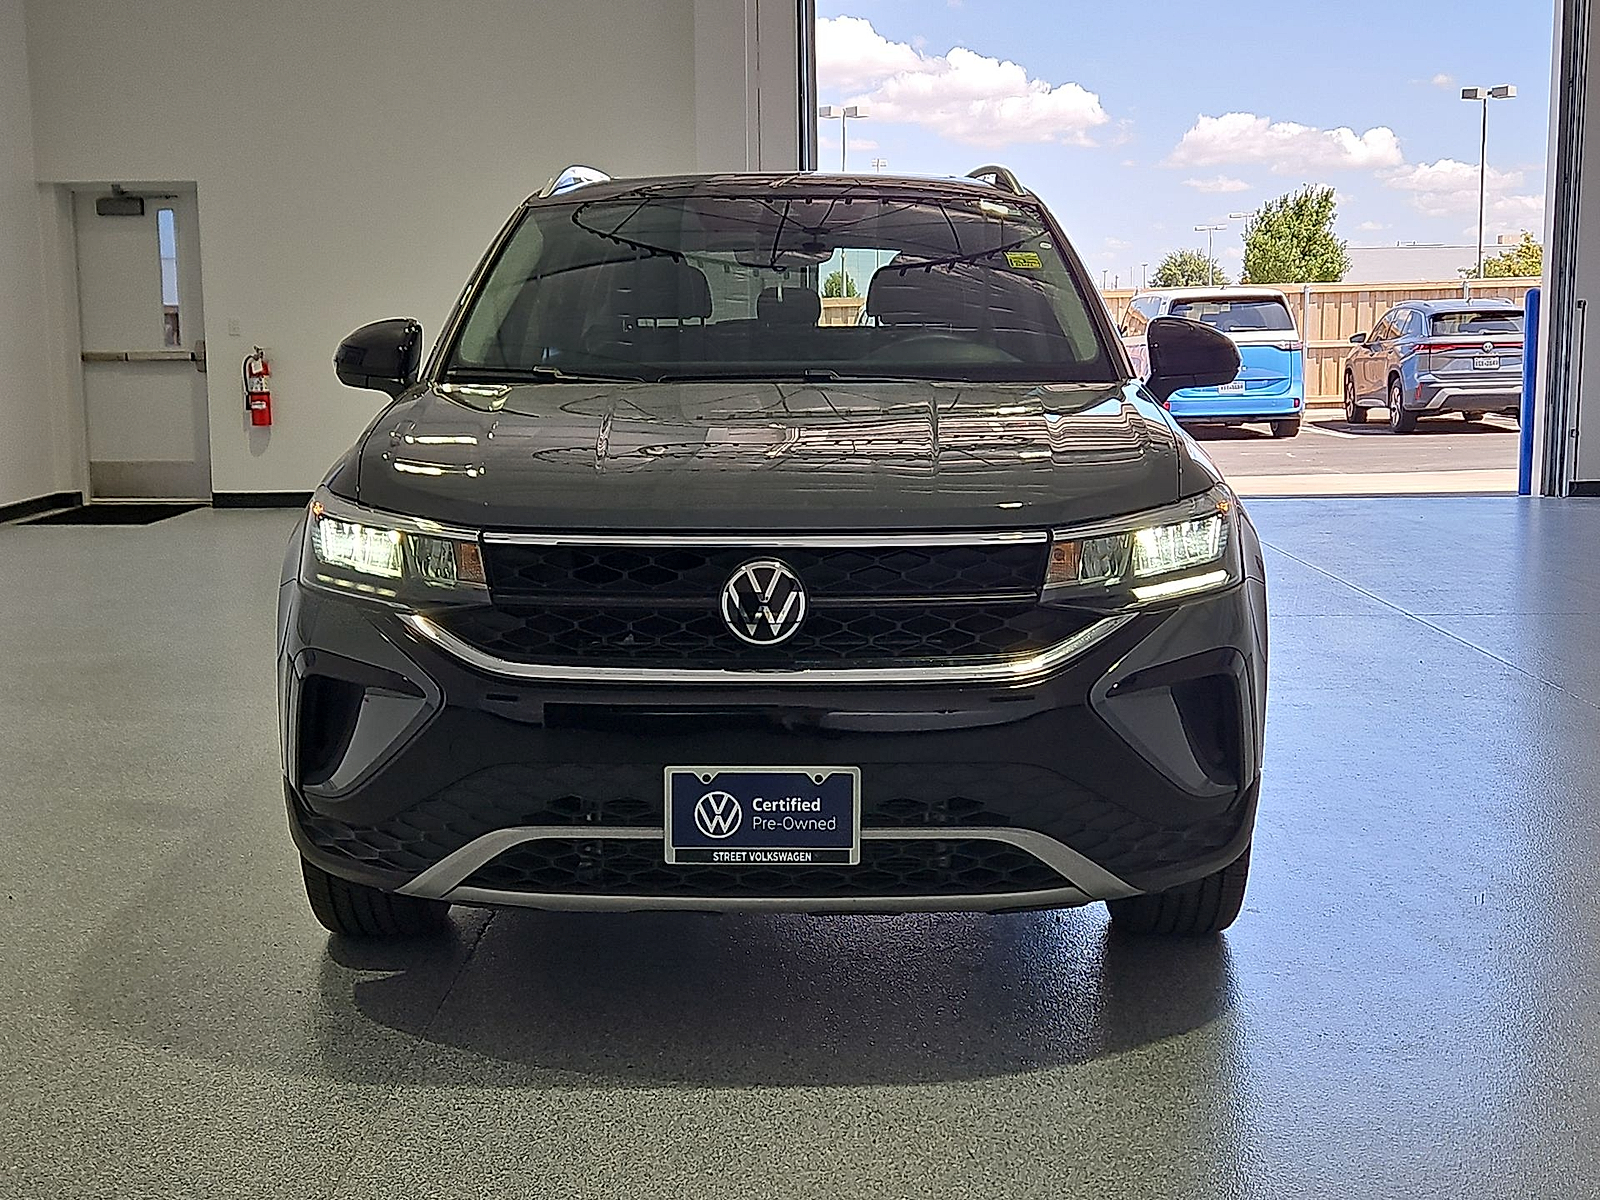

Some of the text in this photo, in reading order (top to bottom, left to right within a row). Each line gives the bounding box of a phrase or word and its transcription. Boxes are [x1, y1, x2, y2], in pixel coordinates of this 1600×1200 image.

[752, 797, 821, 812] Certified
[752, 816, 836, 831] Pre-Owned
[712, 851, 812, 862] STREET VOLKSWAGEN
